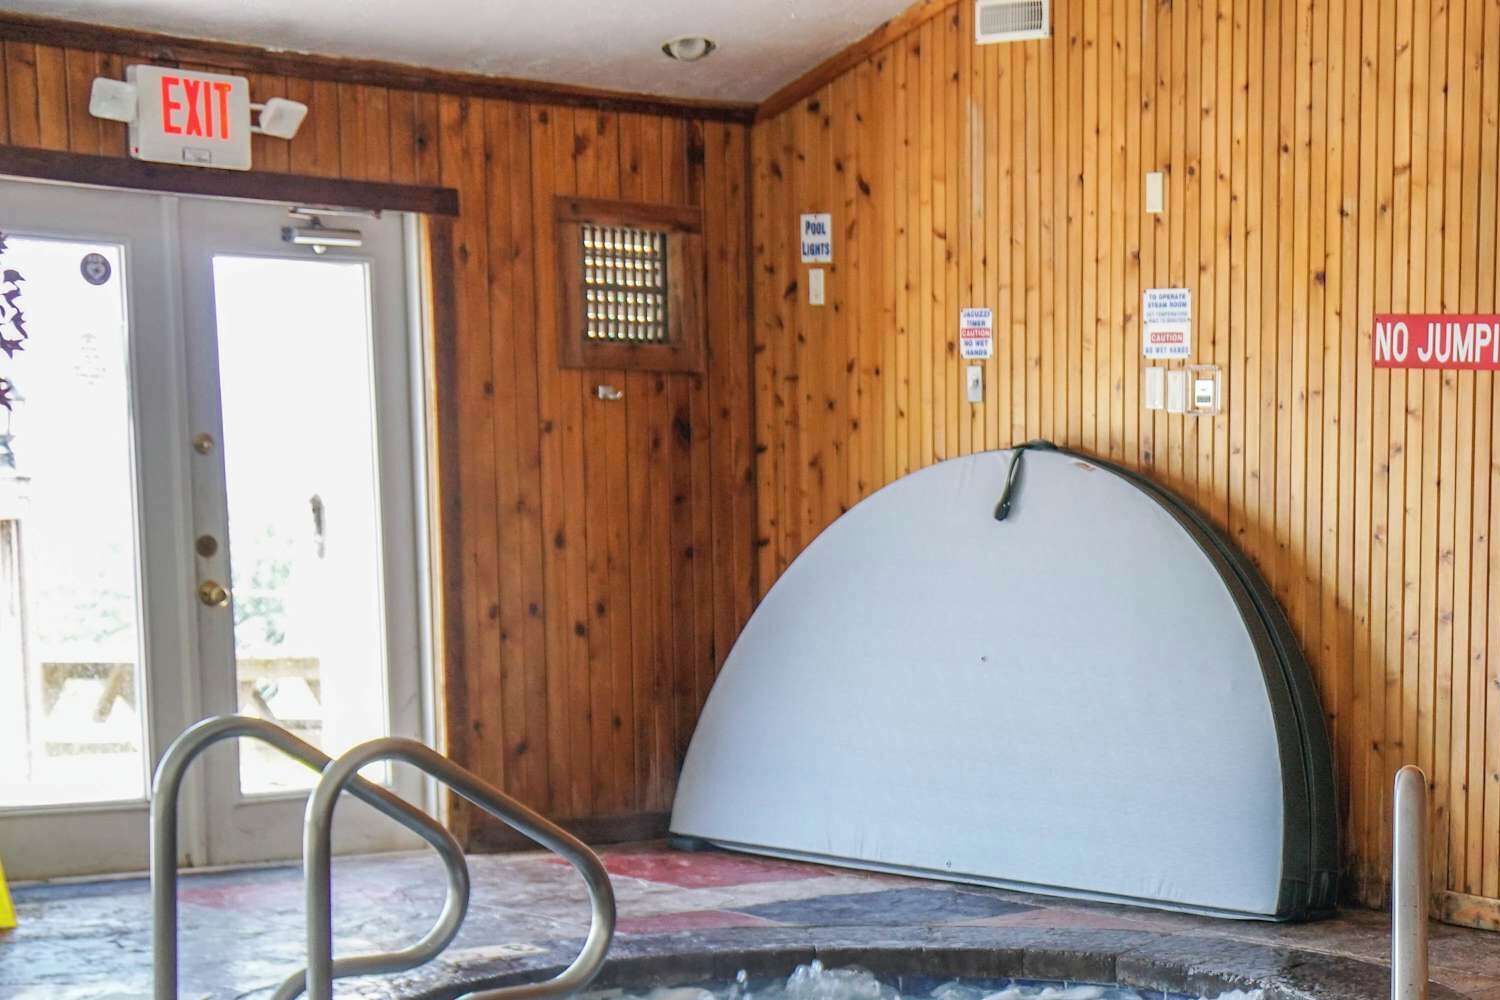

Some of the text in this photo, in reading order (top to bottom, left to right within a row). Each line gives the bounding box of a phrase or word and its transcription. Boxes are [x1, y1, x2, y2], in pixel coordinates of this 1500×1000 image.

[160, 75, 232, 140] EXIT
[805, 220, 826, 235] POOL
[802, 242, 830, 256] LIGHTS
[962, 329, 990, 337] CAUTION
[1152, 333, 1183, 342] CAUTION
[1375, 321, 1409, 363] NO
